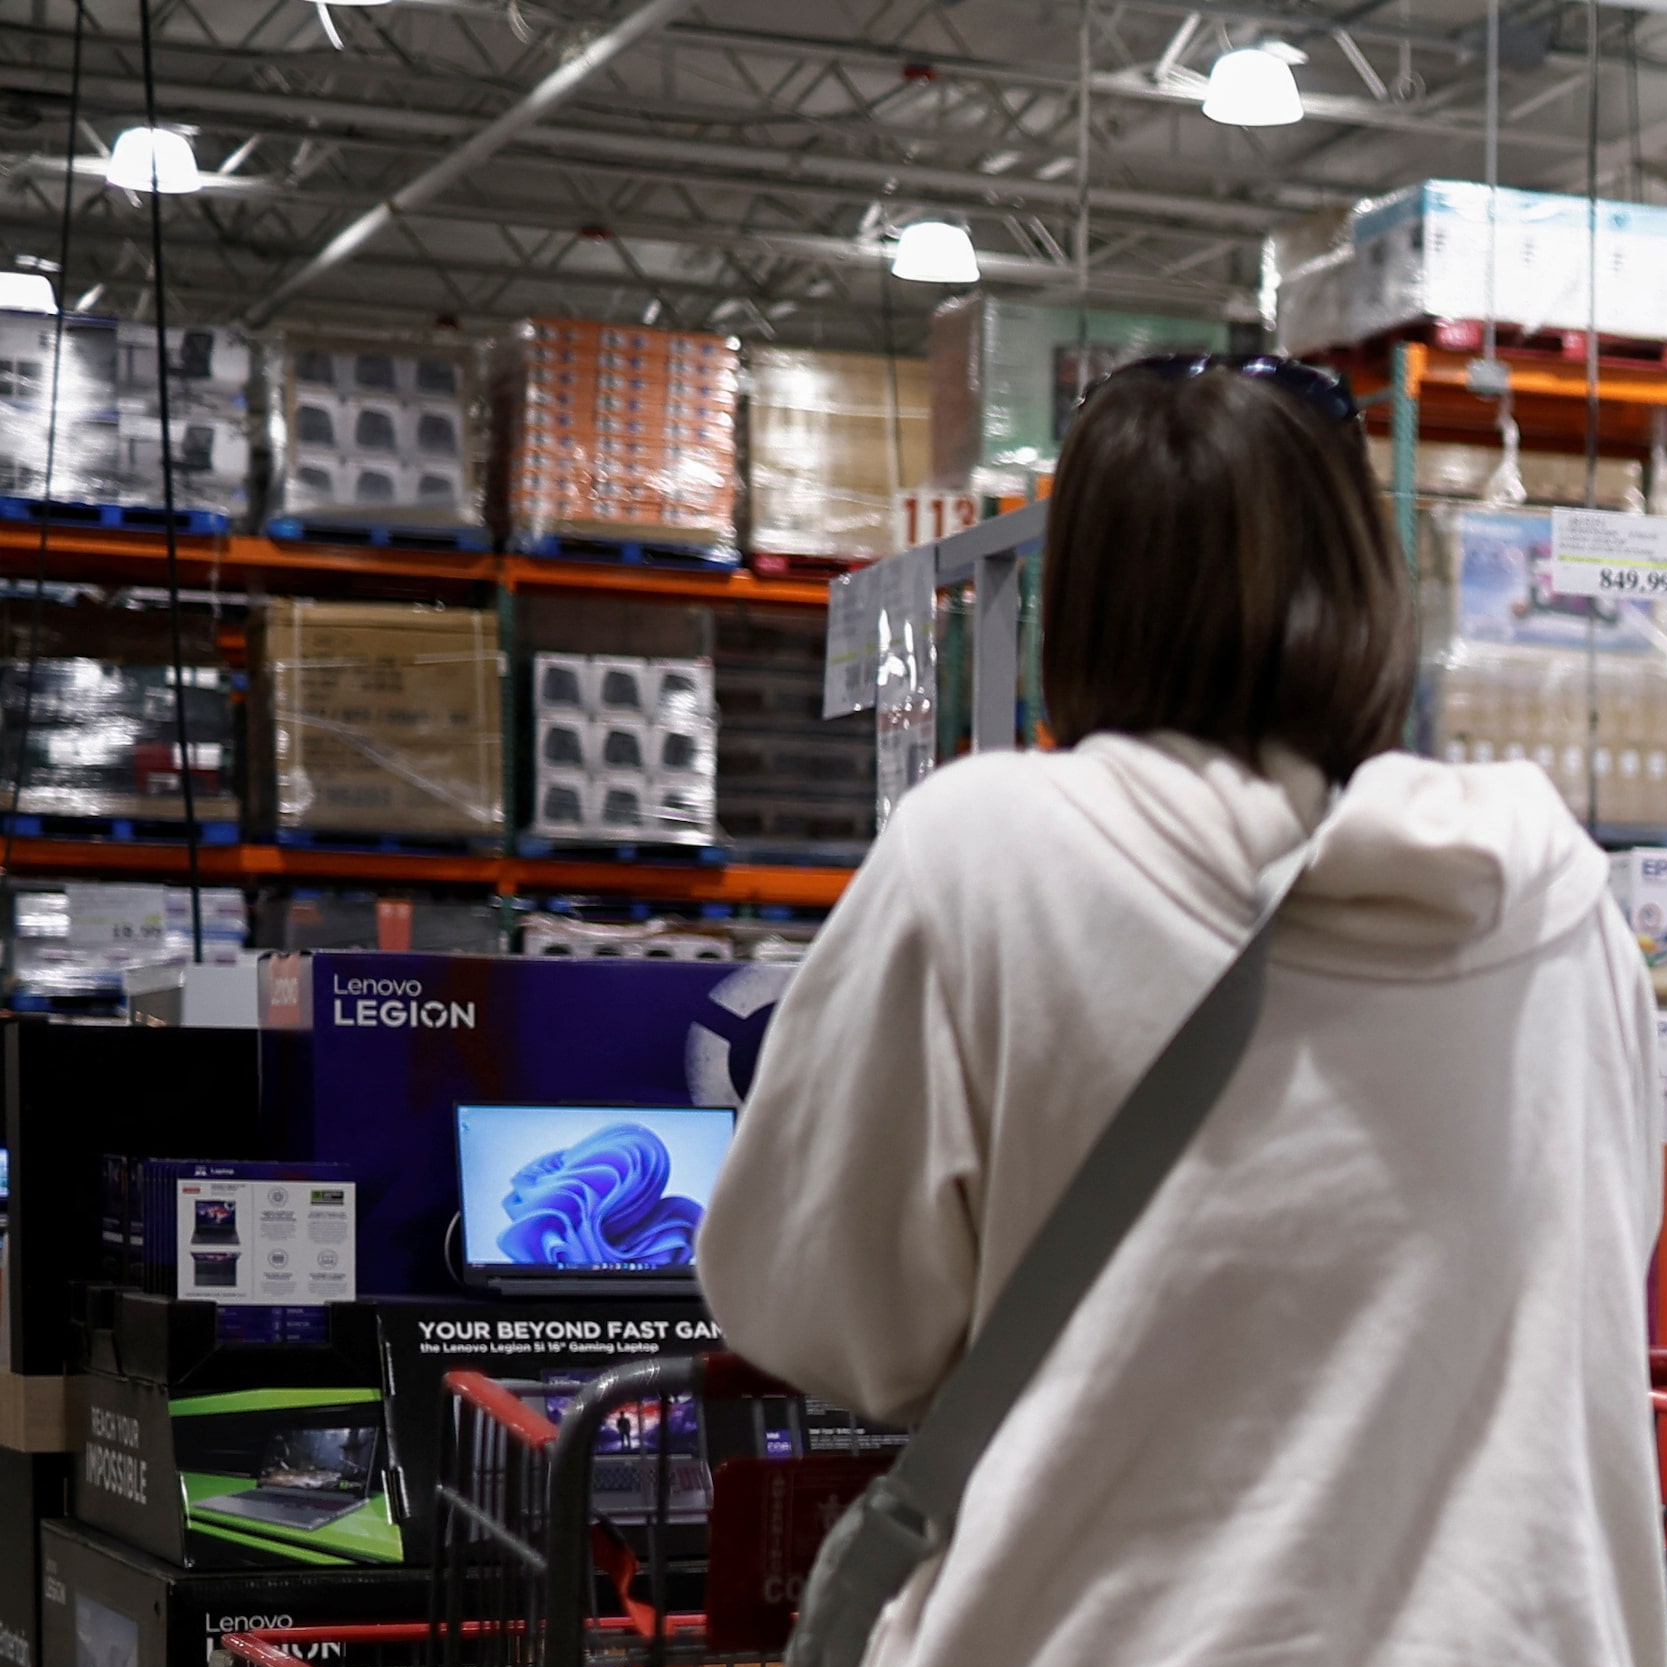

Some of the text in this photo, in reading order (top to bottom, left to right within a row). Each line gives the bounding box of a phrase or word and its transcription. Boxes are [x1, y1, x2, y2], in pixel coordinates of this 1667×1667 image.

[334, 974, 422, 996] Lenovo
[334, 999, 475, 1028] LEGION
[419, 1321, 490, 1340] YOUR
[498, 1321, 600, 1340] BEYOND
[608, 1321, 669, 1339] FAST
[86, 1441, 147, 1504] IMPOSSIBLE
[206, 1613, 293, 1633] Lenovo
